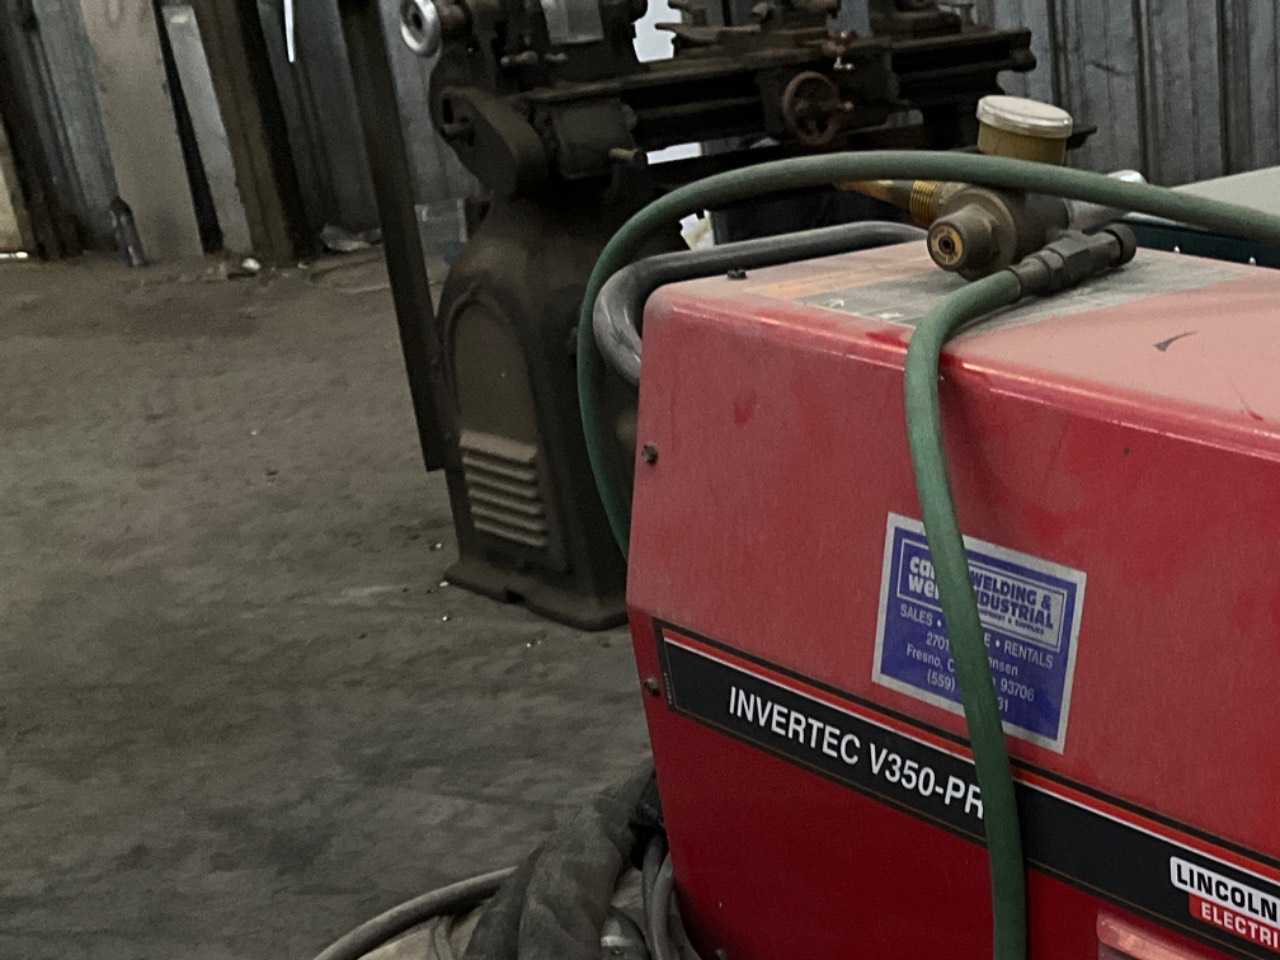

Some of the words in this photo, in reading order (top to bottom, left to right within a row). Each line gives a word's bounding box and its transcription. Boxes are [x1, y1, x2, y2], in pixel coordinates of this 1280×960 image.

[976, 588, 1054, 629] DUSTRIAL
[1041, 594, 1052, 611] &
[900, 603, 934, 627] SALES
[1003, 640, 1054, 669] RENTALS
[906, 642, 943, 669] Fresno,
[1001, 680, 1035, 702] 93706
[926, 668, 956, 692] (559)
[729, 686, 861, 765] INVERTEC
[868, 743, 985, 820] V350-PR
[1176, 863, 1278, 922] LINCOLN
